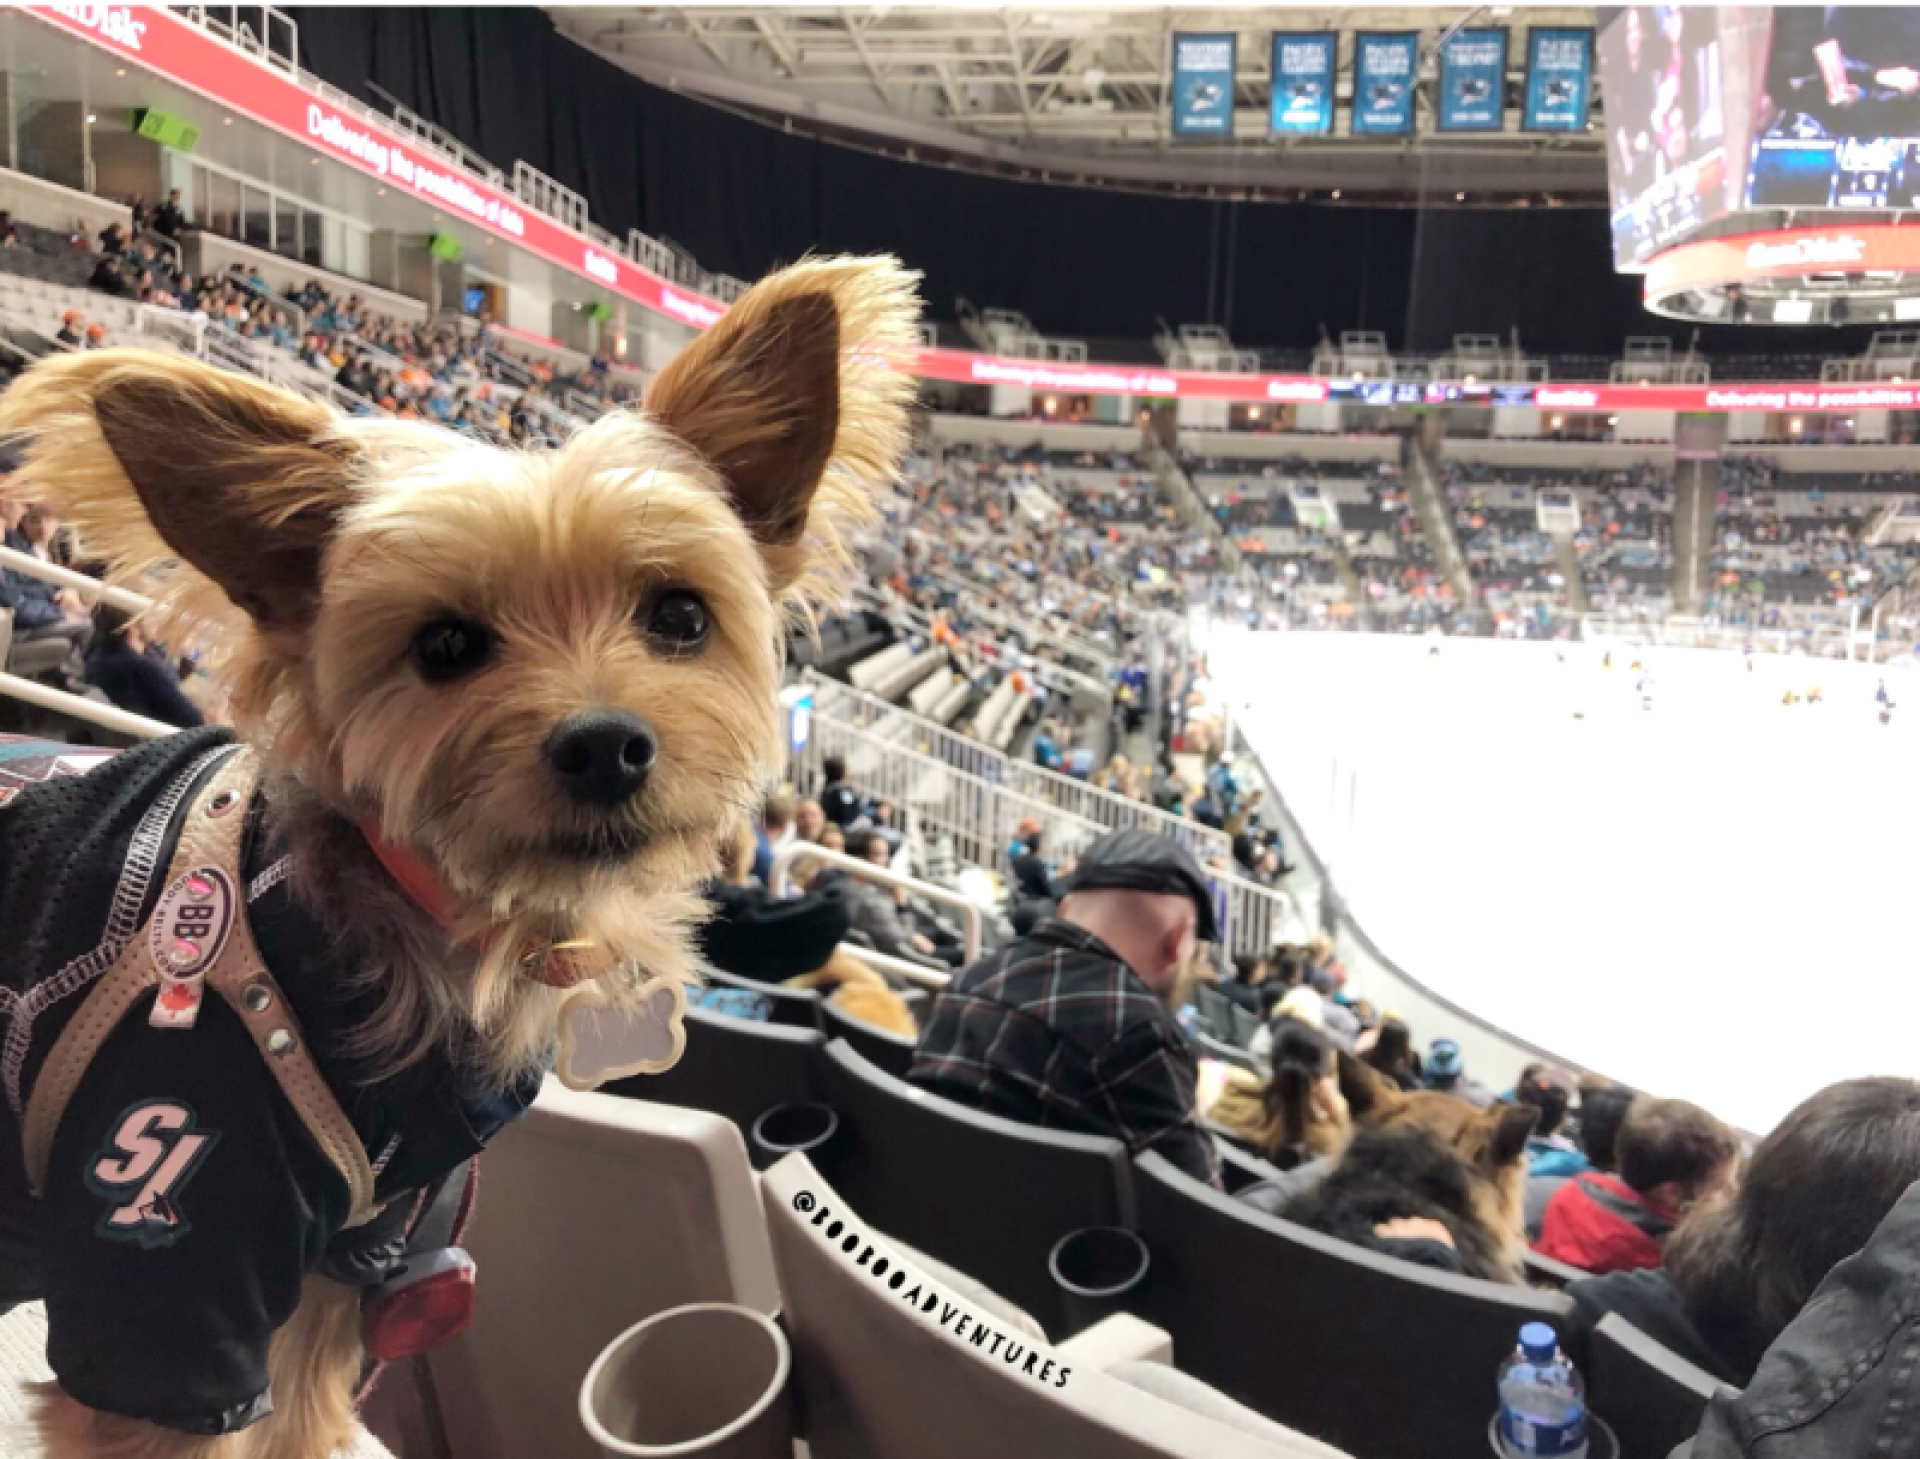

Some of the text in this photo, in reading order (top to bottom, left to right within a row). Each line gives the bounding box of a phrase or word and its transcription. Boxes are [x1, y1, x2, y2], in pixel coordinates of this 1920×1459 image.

[1706, 388, 1915, 409] Delivering the possibilities
